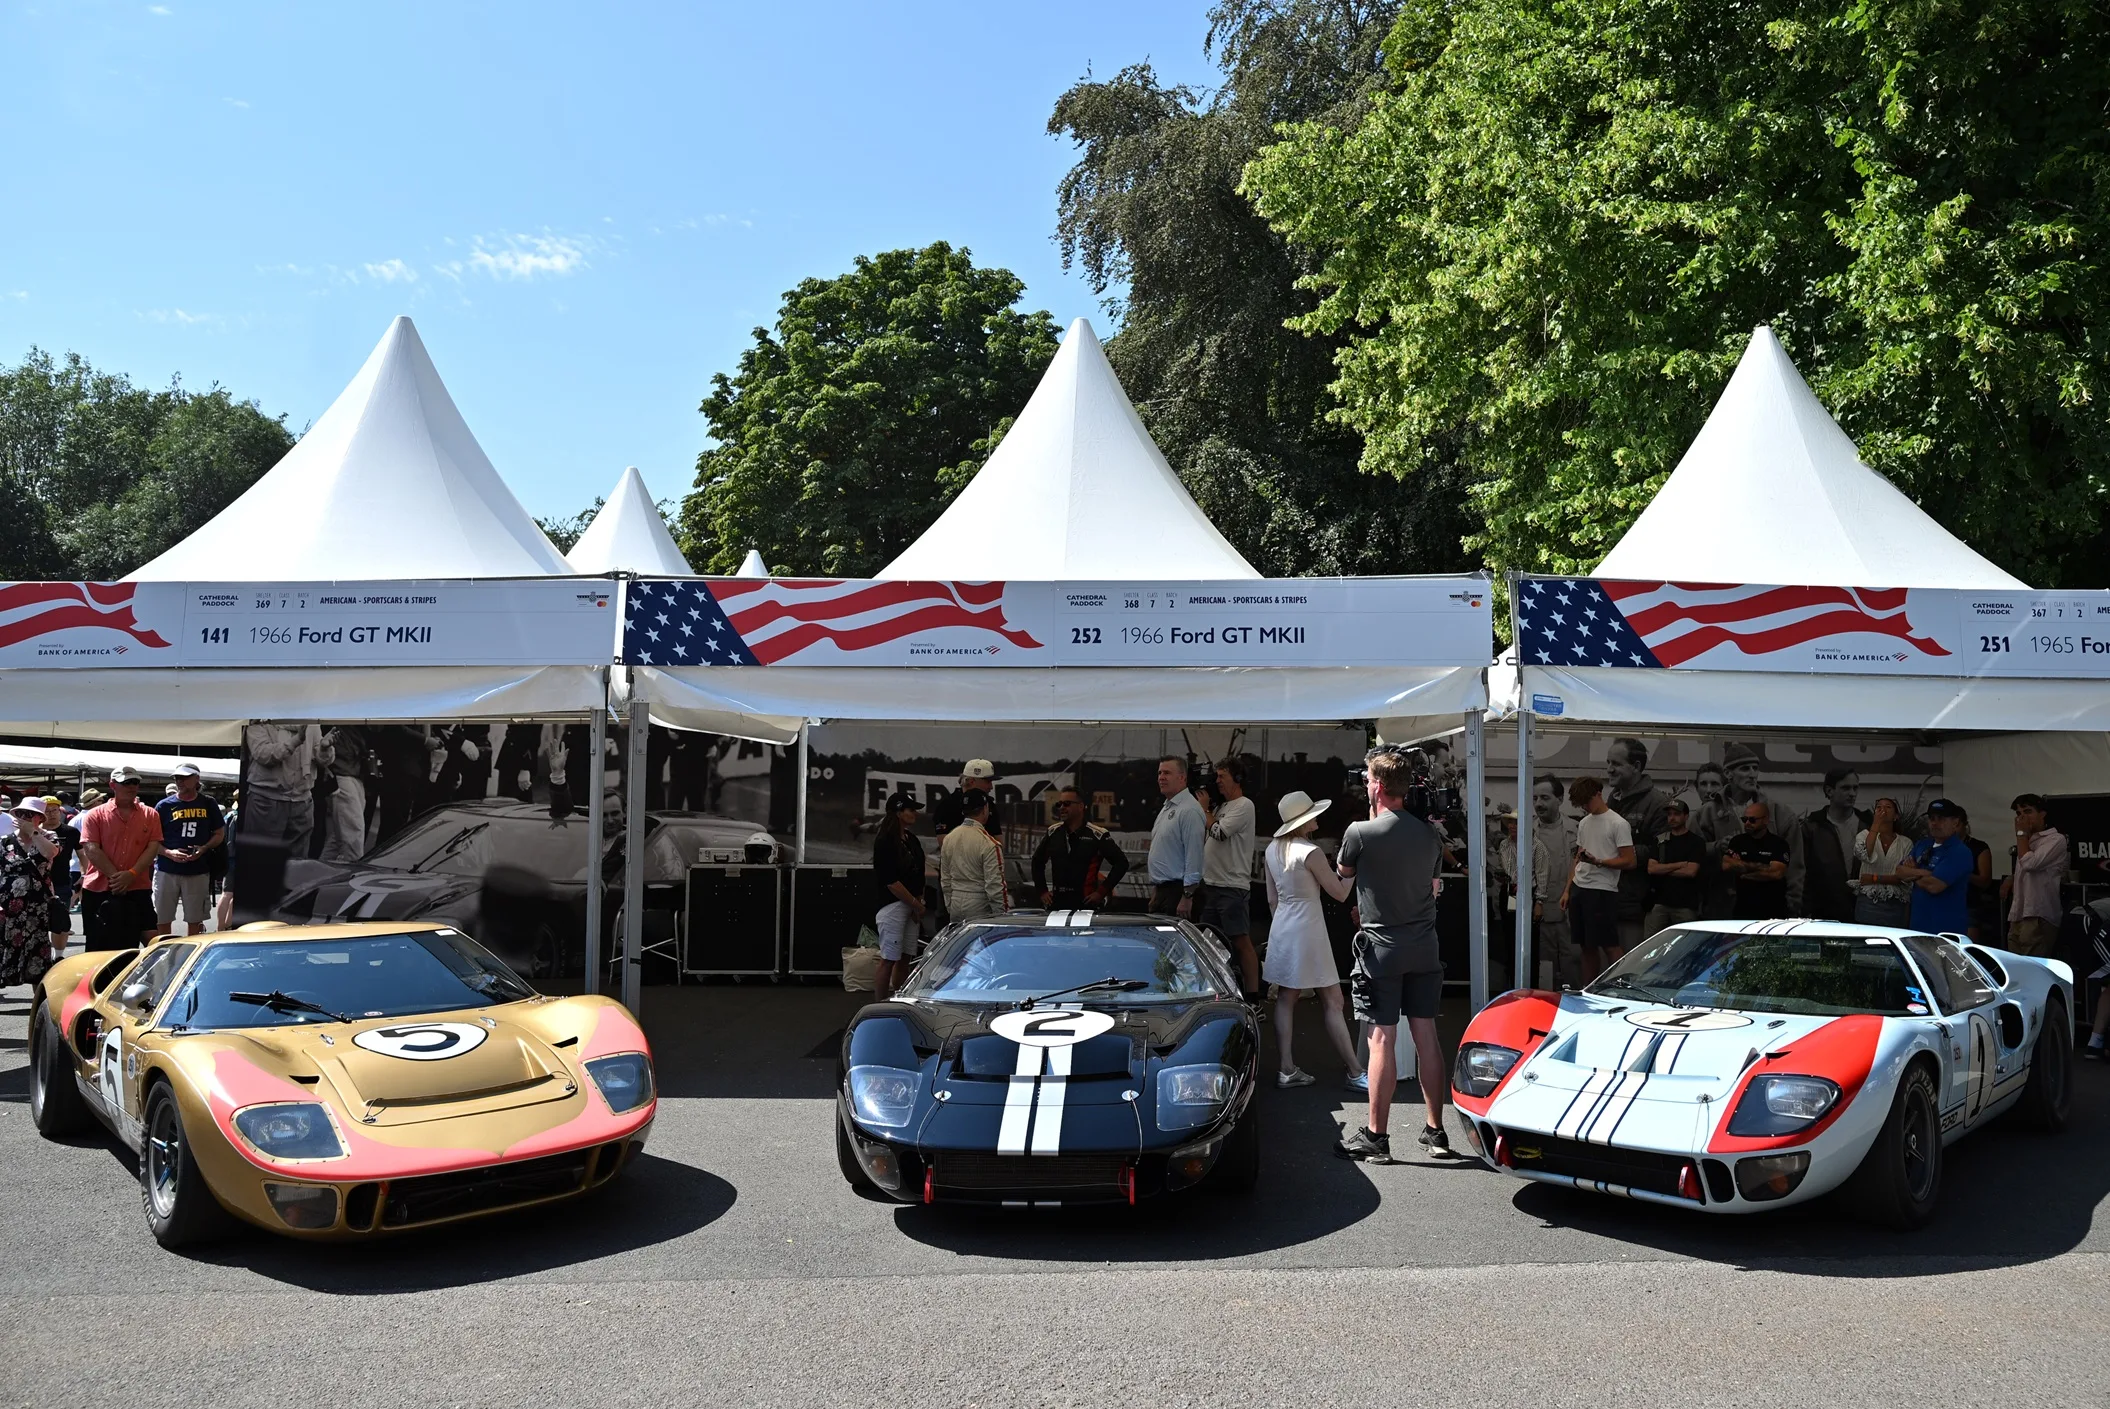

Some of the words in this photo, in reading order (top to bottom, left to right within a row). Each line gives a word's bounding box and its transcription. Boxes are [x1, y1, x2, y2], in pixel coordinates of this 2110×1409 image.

[256, 600, 270, 608] 369
[282, 600, 286, 608] 7
[300, 600, 305, 608] 2
[363, 596, 402, 604] SPORTSCARS
[1124, 600, 1139, 608] 368
[1150, 600, 1155, 608] 7
[1169, 600, 1174, 608] 2
[1233, 596, 1273, 604] SPORTSCARS
[2031, 608, 2046, 617] 367
[2058, 609, 2062, 617] 7
[2077, 609, 2082, 617] 2
[201, 627, 229, 643] 141
[250, 626, 292, 643] 1966
[298, 626, 342, 643] Ford
[349, 626, 380, 643] GT
[386, 626, 431, 643] MKII
[1071, 627, 1102, 644] 252
[1120, 627, 1164, 644] 1966
[1171, 627, 1214, 644] Ford
[1222, 627, 1252, 644] GT
[1259, 627, 1305, 644] MKII
[1980, 636, 2010, 652] 251
[2030, 636, 2074, 653] 1965
[171, 808, 207, 821] DENVER
[181, 821, 197, 838] 15
[1022, 1011, 1084, 1036] 2
[1650, 1012, 1711, 1028] 1
[376, 1023, 461, 1053] 5
[1969, 1022, 1985, 1118] 1
